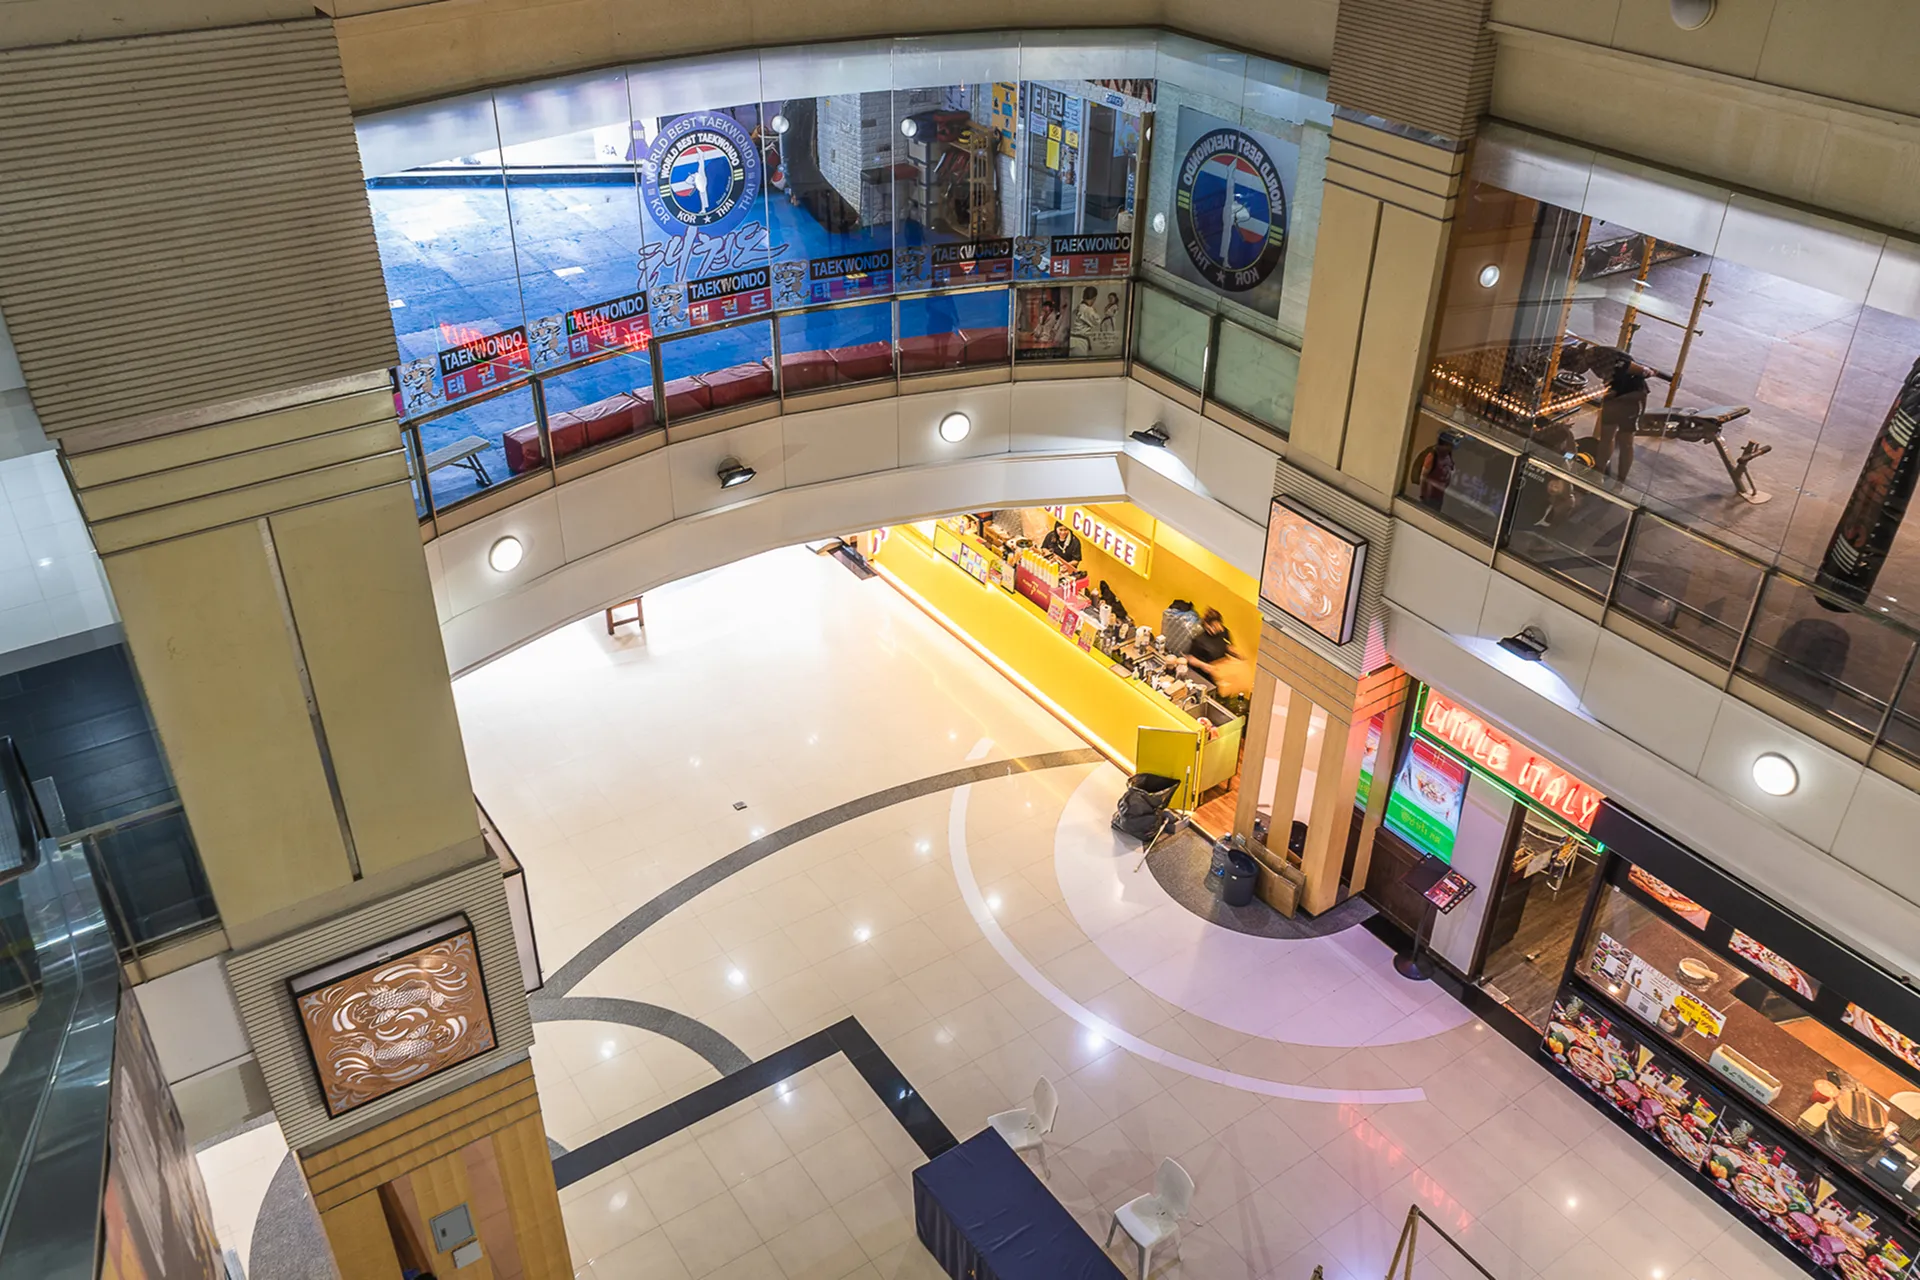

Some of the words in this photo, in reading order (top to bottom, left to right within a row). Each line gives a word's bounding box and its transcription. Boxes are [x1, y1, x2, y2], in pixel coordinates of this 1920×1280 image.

[647, 138, 668, 184] WORLD
[668, 117, 697, 140] BEST
[698, 116, 755, 168] TAEKWONDO
[661, 147, 679, 179] WORLD
[676, 135, 696, 150] BEST
[698, 133, 739, 166] TAEKWONDO
[651, 198, 671, 224] KOR
[738, 183, 756, 211] THAI
[677, 210, 697, 224] KOR
[716, 199, 735, 217] THAI
[935, 241, 1009, 262] TAEKWONDO
[1054, 236, 1130, 252] TAEKWONDO
[812, 255, 889, 276] TAEKWONDO
[1053, 257, 1131, 275] 태권도
[690, 271, 766, 298] TAEKWONDO
[568, 296, 644, 331] TAEKWONDO
[692, 294, 768, 321] 태권도
[442, 331, 522, 370] TAEKWONDO
[1073, 510, 1136, 566] COFFEE
[1425, 701, 1510, 771] LITTLE
[1518, 758, 1600, 823] ITALY
